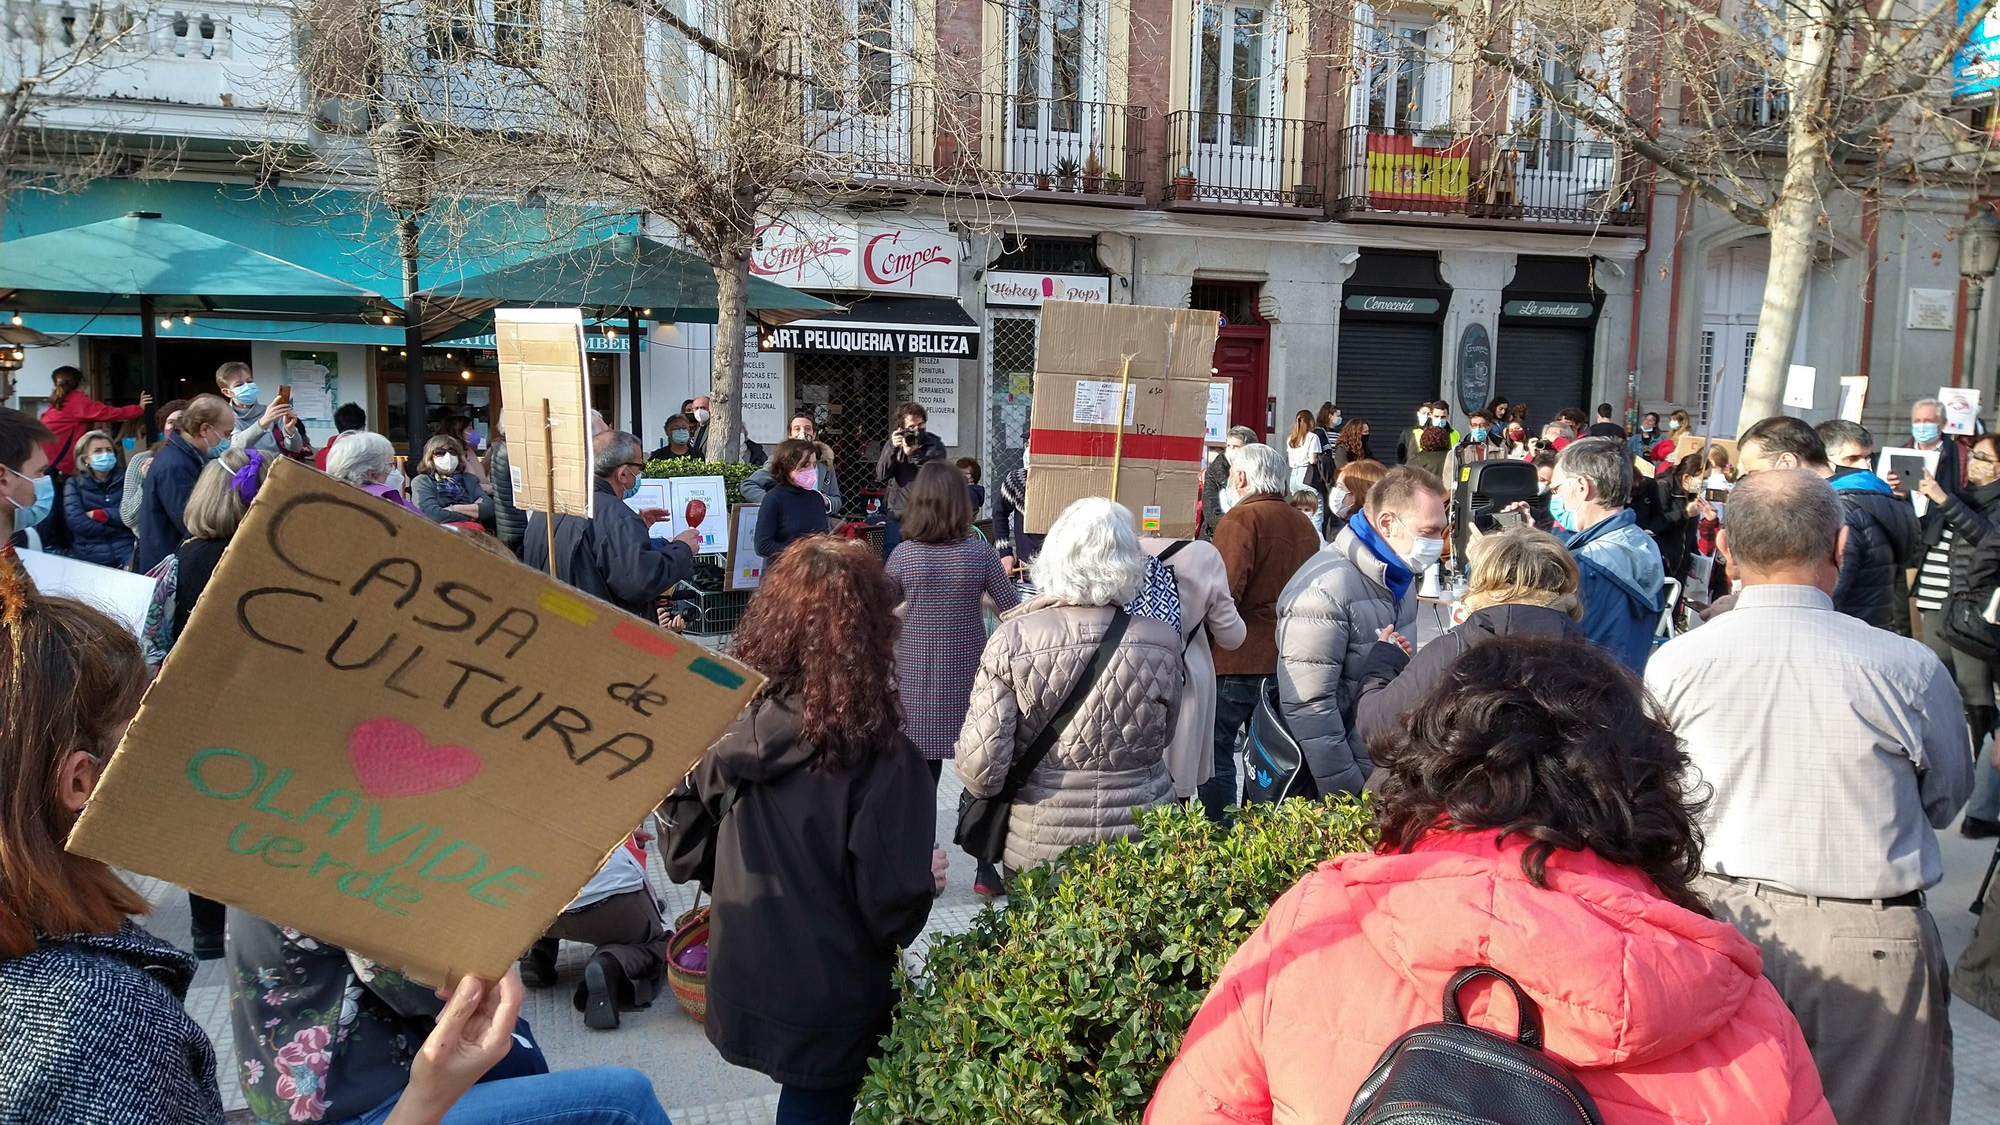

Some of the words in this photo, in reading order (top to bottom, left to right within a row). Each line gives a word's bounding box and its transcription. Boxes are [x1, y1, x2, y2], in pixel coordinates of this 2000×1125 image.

[863, 230, 952, 288] Comper
[990, 282, 1040, 302] Hokey
[1066, 287, 1101, 303] Pops
[1363, 297, 1415, 312] Cervecería
[1518, 302, 1538, 316] La
[1538, 303, 1580, 317] contenta
[804, 330, 893, 352] PELUQUERIA
[893, 332, 904, 352] Y
[908, 333, 970, 354] BELLEZA
[918, 357, 940, 365] BELLEZA
[918, 367, 945, 375] FORNITURA
[756, 382, 771, 390] PARA
[918, 377, 955, 385] APARATOLOGIA
[749, 392, 773, 400] BELLEZA
[918, 387, 954, 395] HERRAMIENTAS
[918, 396, 932, 404] TODO
[926, 406, 956, 414] PELUQUERIA
[266, 492, 540, 660] CASA
[237, 586, 655, 782] CULTURA
[606, 673, 668, 718] de
[185, 746, 545, 909] OLAVIDE
